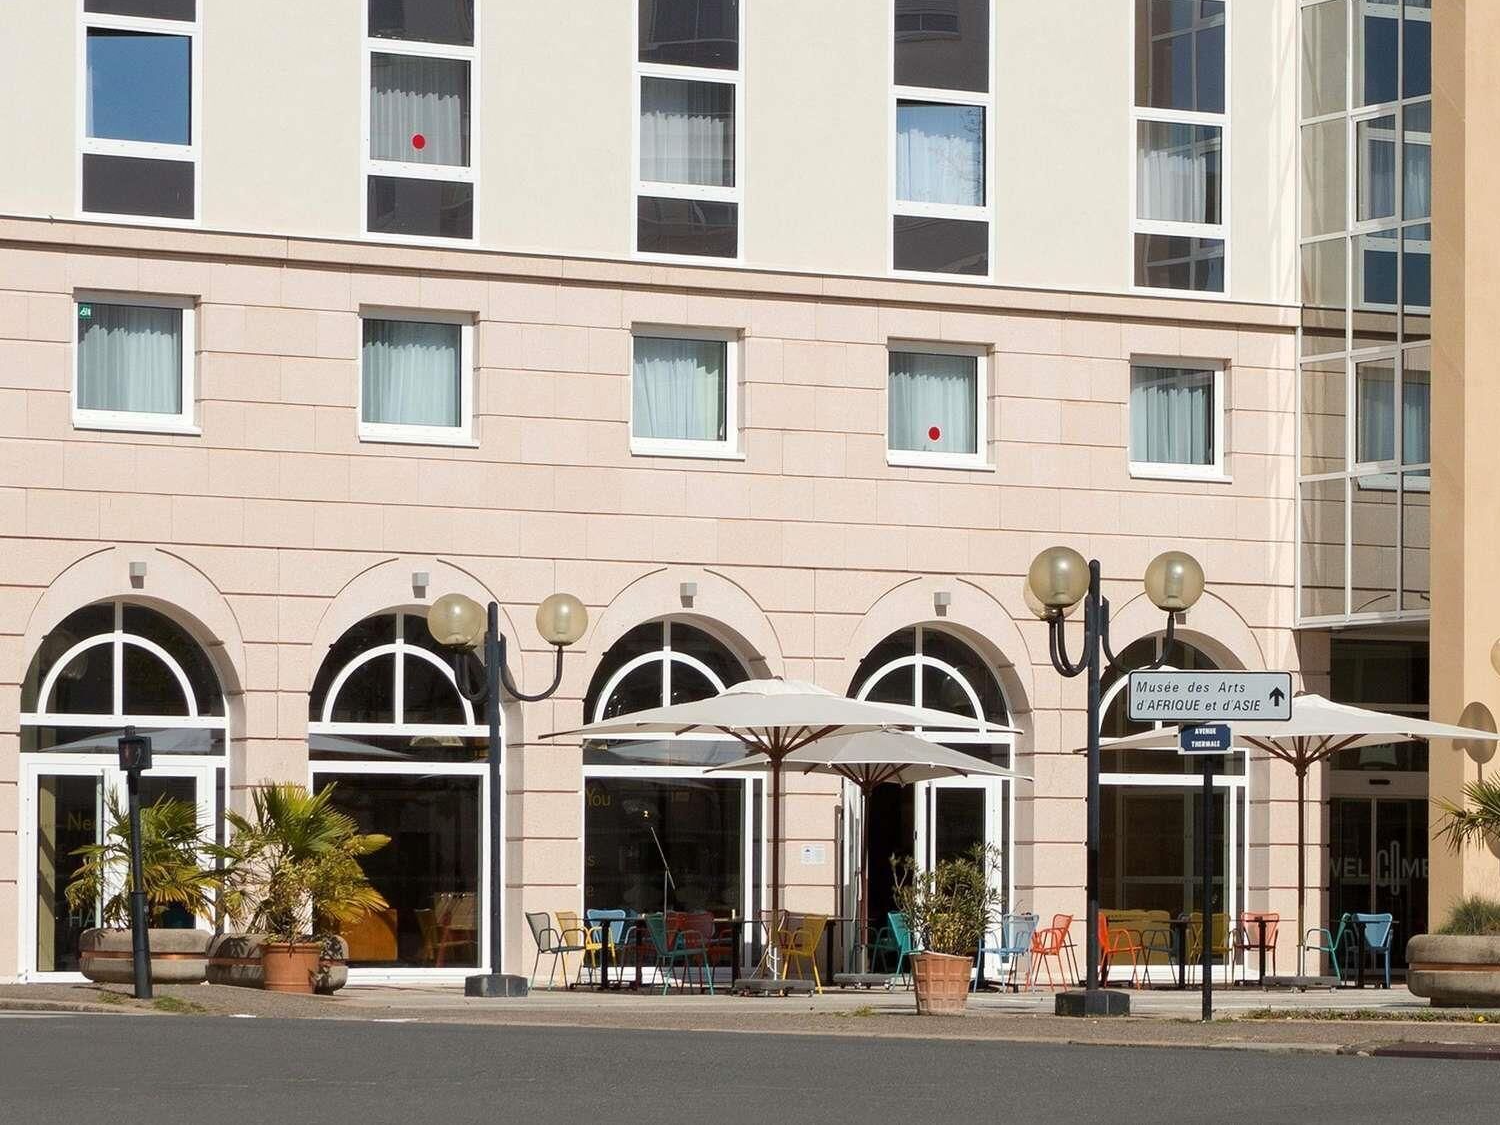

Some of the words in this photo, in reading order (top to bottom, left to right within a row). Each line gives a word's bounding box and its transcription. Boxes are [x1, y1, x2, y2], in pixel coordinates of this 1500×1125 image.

[1136, 681, 1180, 693] Musée
[1187, 681, 1210, 693] des
[1217, 681, 1246, 693] Arts
[1136, 699, 1201, 712] d'AFRIQUE
[1205, 701, 1217, 712] et
[1222, 699, 1261, 712] d'ASIE
[1194, 727, 1217, 735] AVENUE
[1191, 740, 1221, 748] THERMALE
